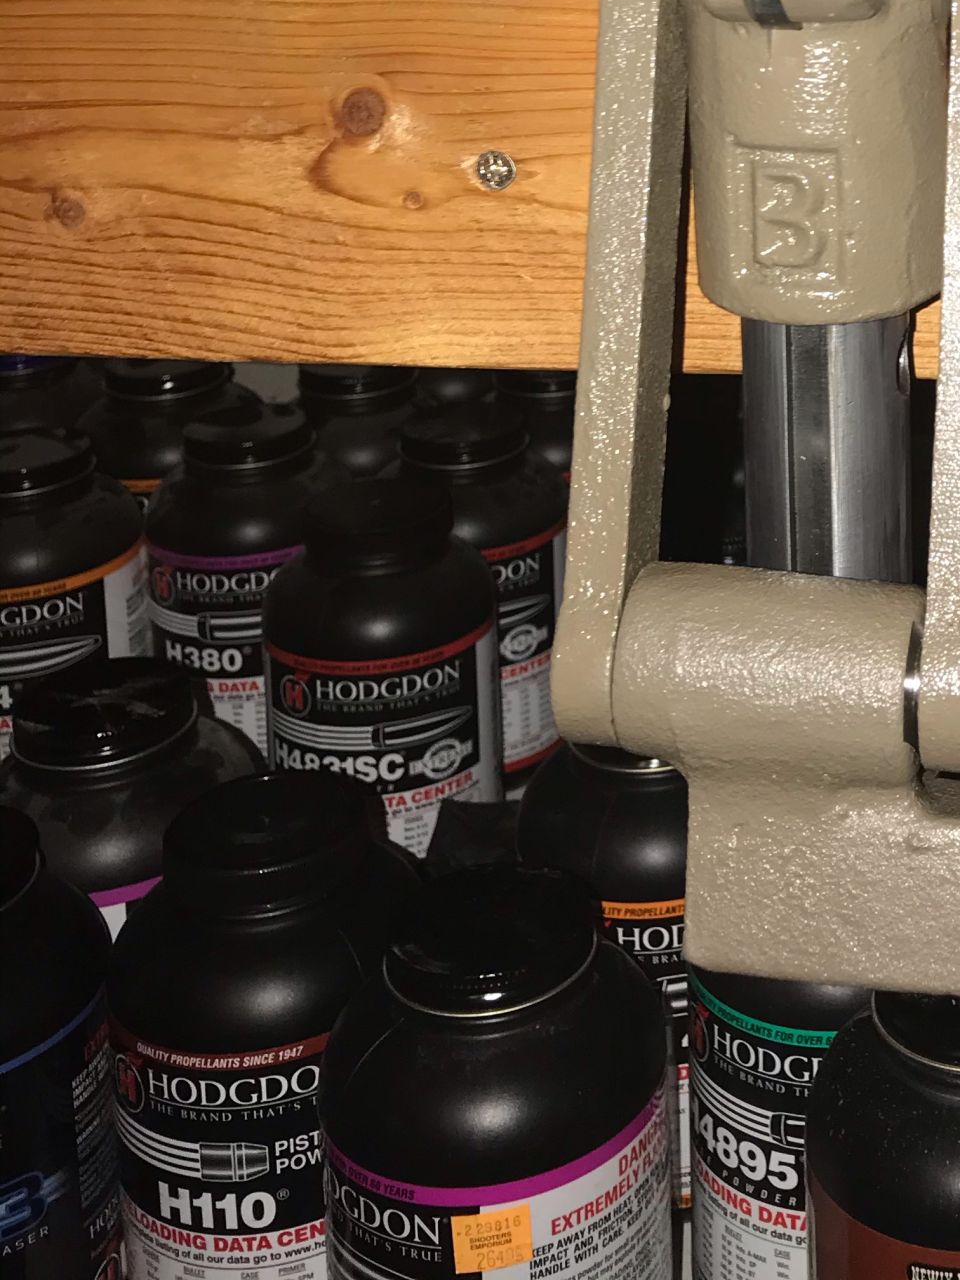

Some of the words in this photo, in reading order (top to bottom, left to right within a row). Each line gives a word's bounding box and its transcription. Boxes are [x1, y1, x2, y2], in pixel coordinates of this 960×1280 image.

[165, 638, 244, 673] H380
[218, 680, 259, 693] DATA
[316, 660, 462, 702] HODGDON
[411, 770, 474, 804] CENTER
[796, 1033, 822, 1047] OVER
[137, 1041, 169, 1062] QUALITY
[170, 1052, 240, 1069] PROPELLANTS
[242, 1051, 275, 1067] SINCE
[277, 1045, 304, 1062] 1947
[180, 1109, 233, 1122] BRAND
[241, 1100, 301, 1120] THAT'S
[384, 1184, 416, 1201] YEARS
[551, 1166, 639, 1236] EXTREMELY
[213, 1232, 273, 1254] DATA
[469, 1231, 512, 1245] SHOOTERS
[556, 1229, 585, 1251] AWAY
[587, 1214, 612, 1234] FROM
[770, 1229, 793, 1243] data
[400, 1245, 443, 1263] TRUE
[470, 1238, 513, 1251] EMPORIUM
[529, 1249, 569, 1271] IMPACT
[572, 1236, 594, 1255] AND
[207, 1256, 224, 1264] our
[227, 1254, 251, 1265] data
[254, 1254, 268, 1265] go
[270, 1252, 282, 1261] to
[529, 1260, 570, 1280] HANDLE
[574, 1244, 599, 1265] WITH
